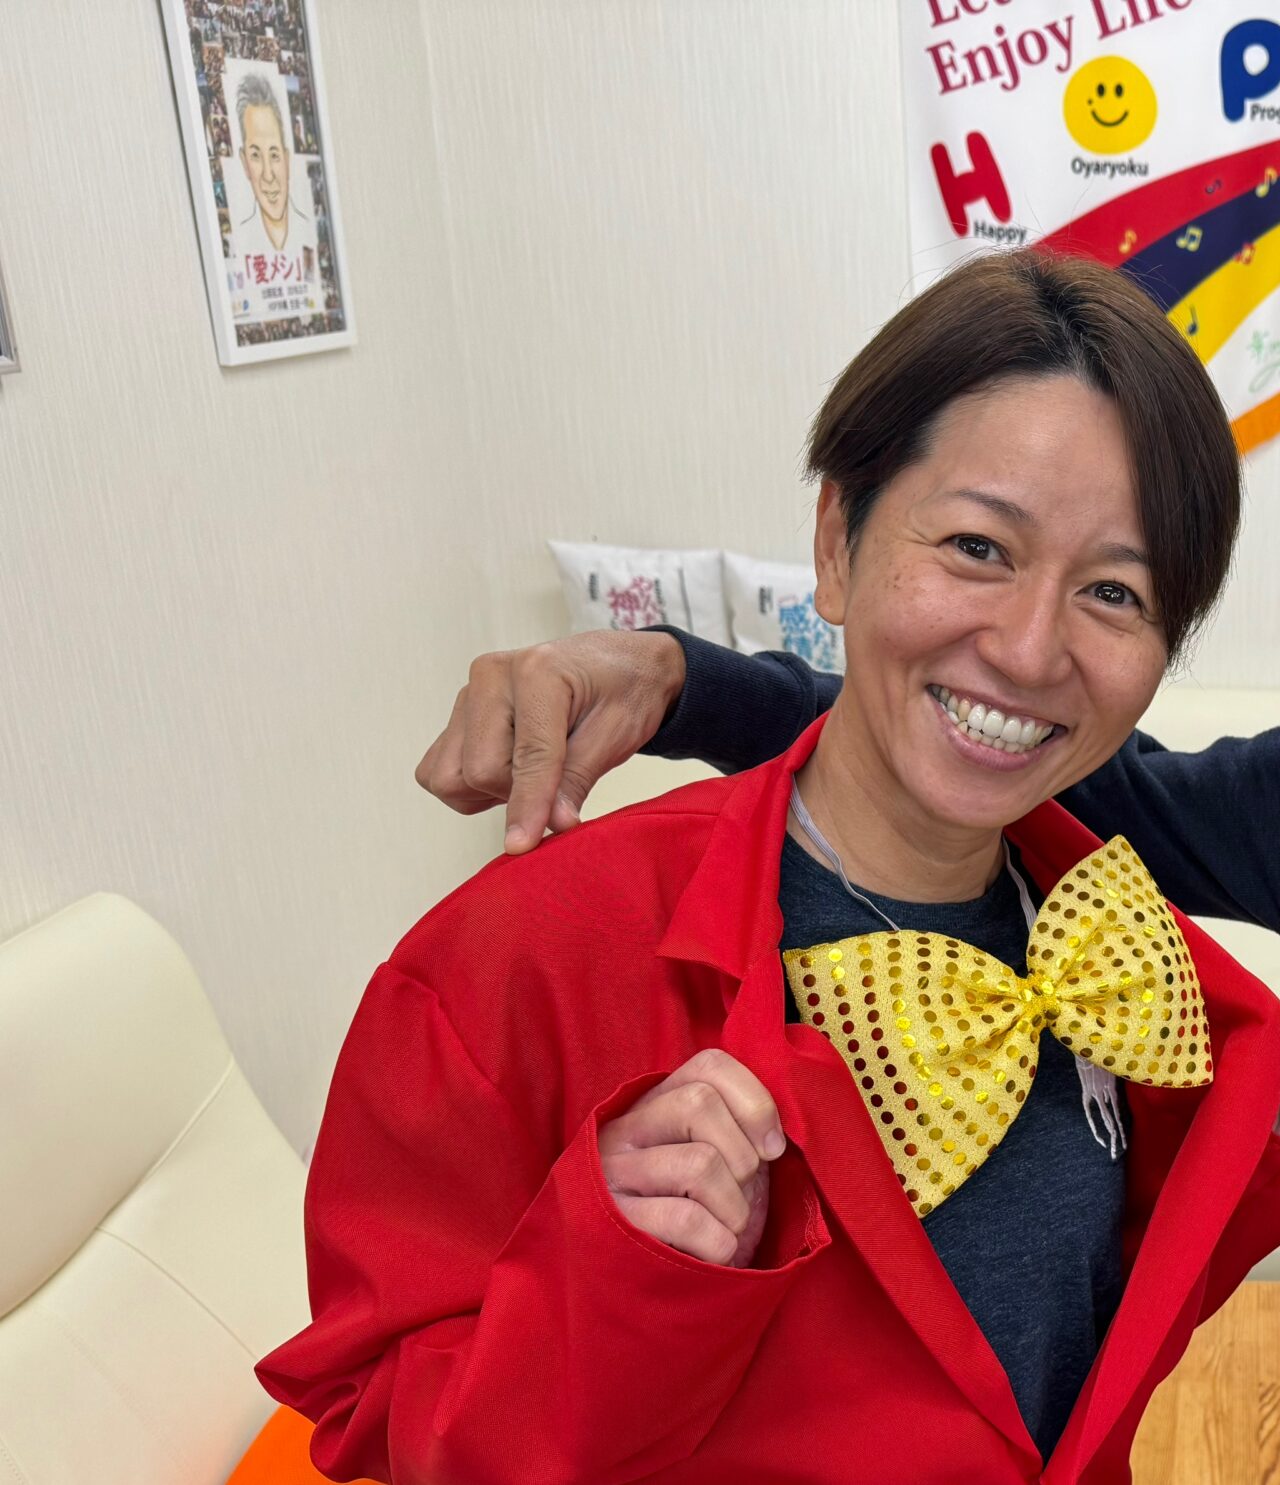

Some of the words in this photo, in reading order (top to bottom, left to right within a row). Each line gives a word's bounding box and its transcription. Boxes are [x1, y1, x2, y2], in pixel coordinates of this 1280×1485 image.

[925, 15, 1073, 95] Enjoy
[1071, 156, 1149, 179] Oyaryoku
[973, 219, 1028, 243] Happy
